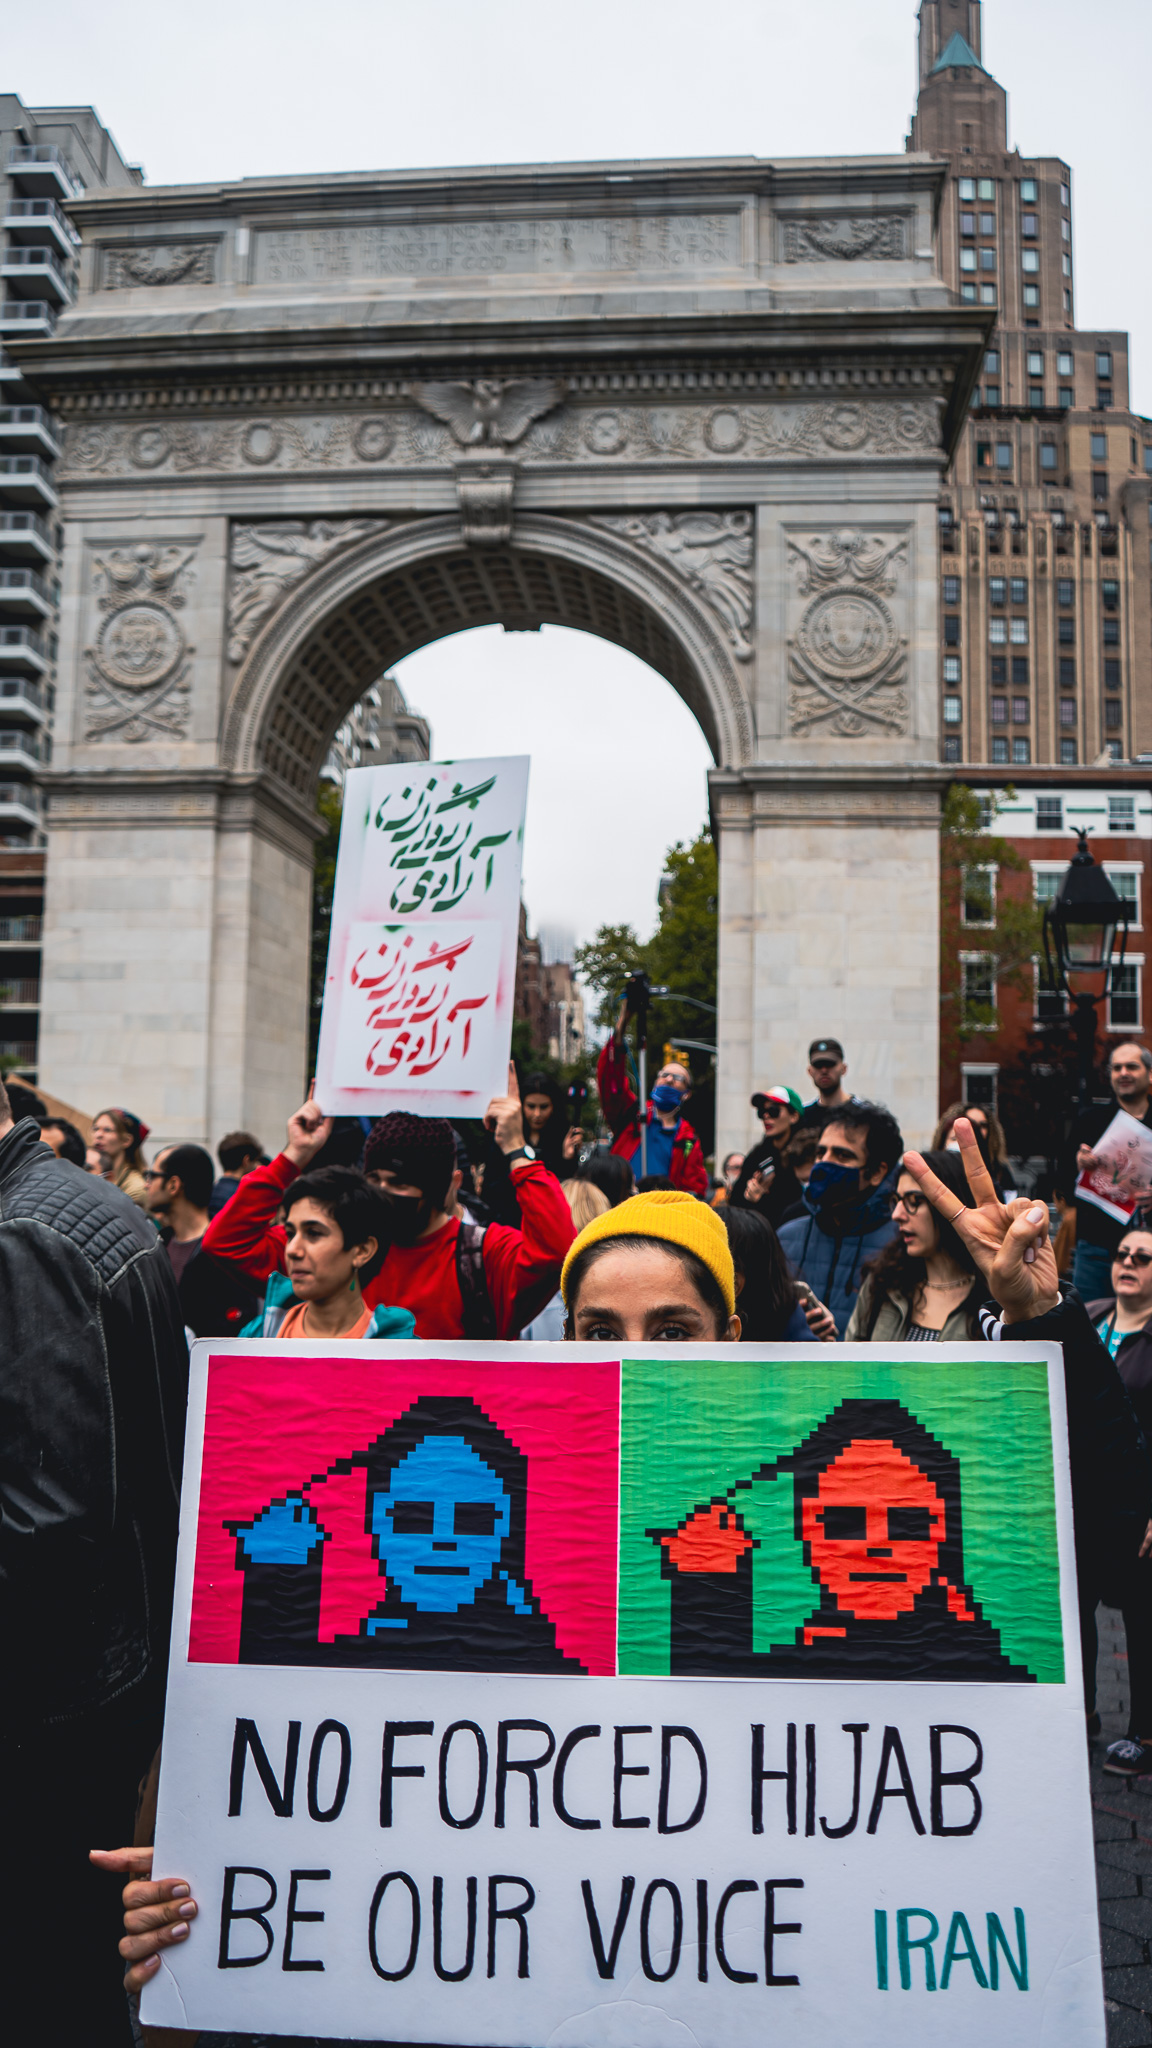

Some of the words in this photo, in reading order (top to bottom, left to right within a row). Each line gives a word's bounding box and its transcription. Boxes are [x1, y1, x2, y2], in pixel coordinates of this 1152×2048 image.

[264, 232, 304, 248] LET
[307, 230, 330, 246] US
[332, 228, 390, 244] RAISE
[526, 221, 556, 237] TO
[264, 248, 305, 263] AND
[311, 245, 352, 262] THE
[359, 241, 440, 259] HONEST
[448, 239, 495, 256] CAN
[658, 231, 728, 249] EVENT
[313, 261, 352, 276] THE
[361, 257, 420, 274] HAND
[426, 256, 454, 272] OF
[460, 254, 508, 271] GOD
[390, 830, 513, 914] آزادی
[365, 993, 490, 1077] آزادی
[227, 1717, 352, 1823] NO
[379, 1718, 708, 1835] FORCED
[750, 1722, 984, 1840] HIJAB
[216, 1865, 332, 1973] BE
[367, 1870, 536, 1983] OUR
[580, 1875, 805, 1987] VOICE
[874, 1906, 1029, 1992] IRAN
